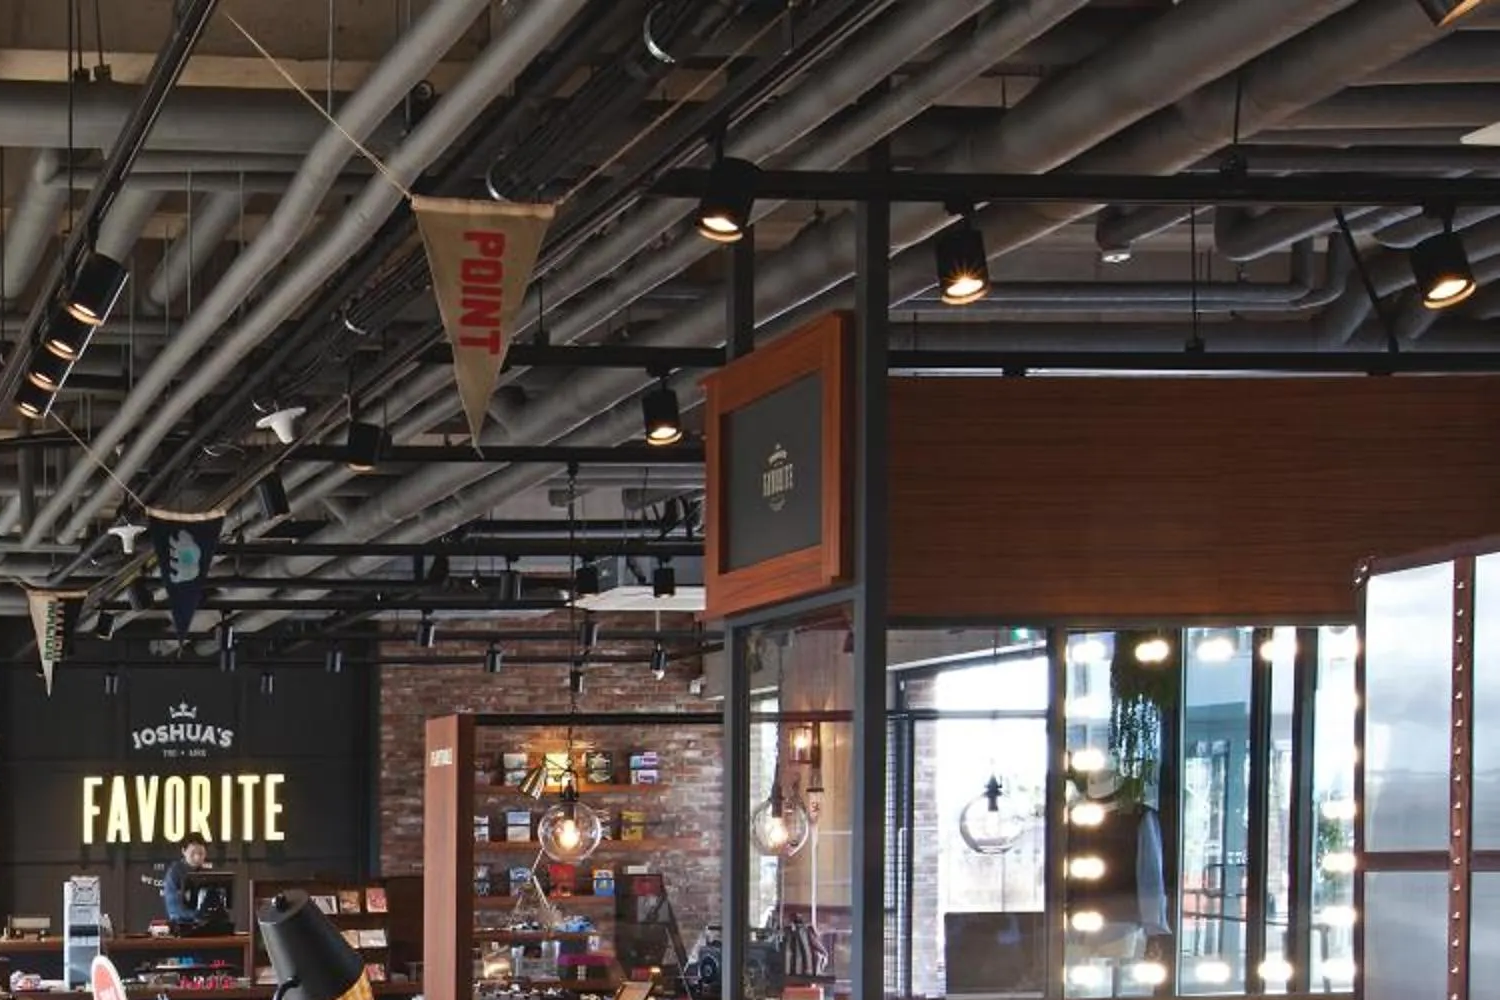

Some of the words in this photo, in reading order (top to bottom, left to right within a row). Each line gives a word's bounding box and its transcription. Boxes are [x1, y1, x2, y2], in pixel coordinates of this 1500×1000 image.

[460, 232, 505, 355] POINT
[132, 722, 235, 750] JOSHUA'S
[82, 773, 285, 844] FAVORITE
